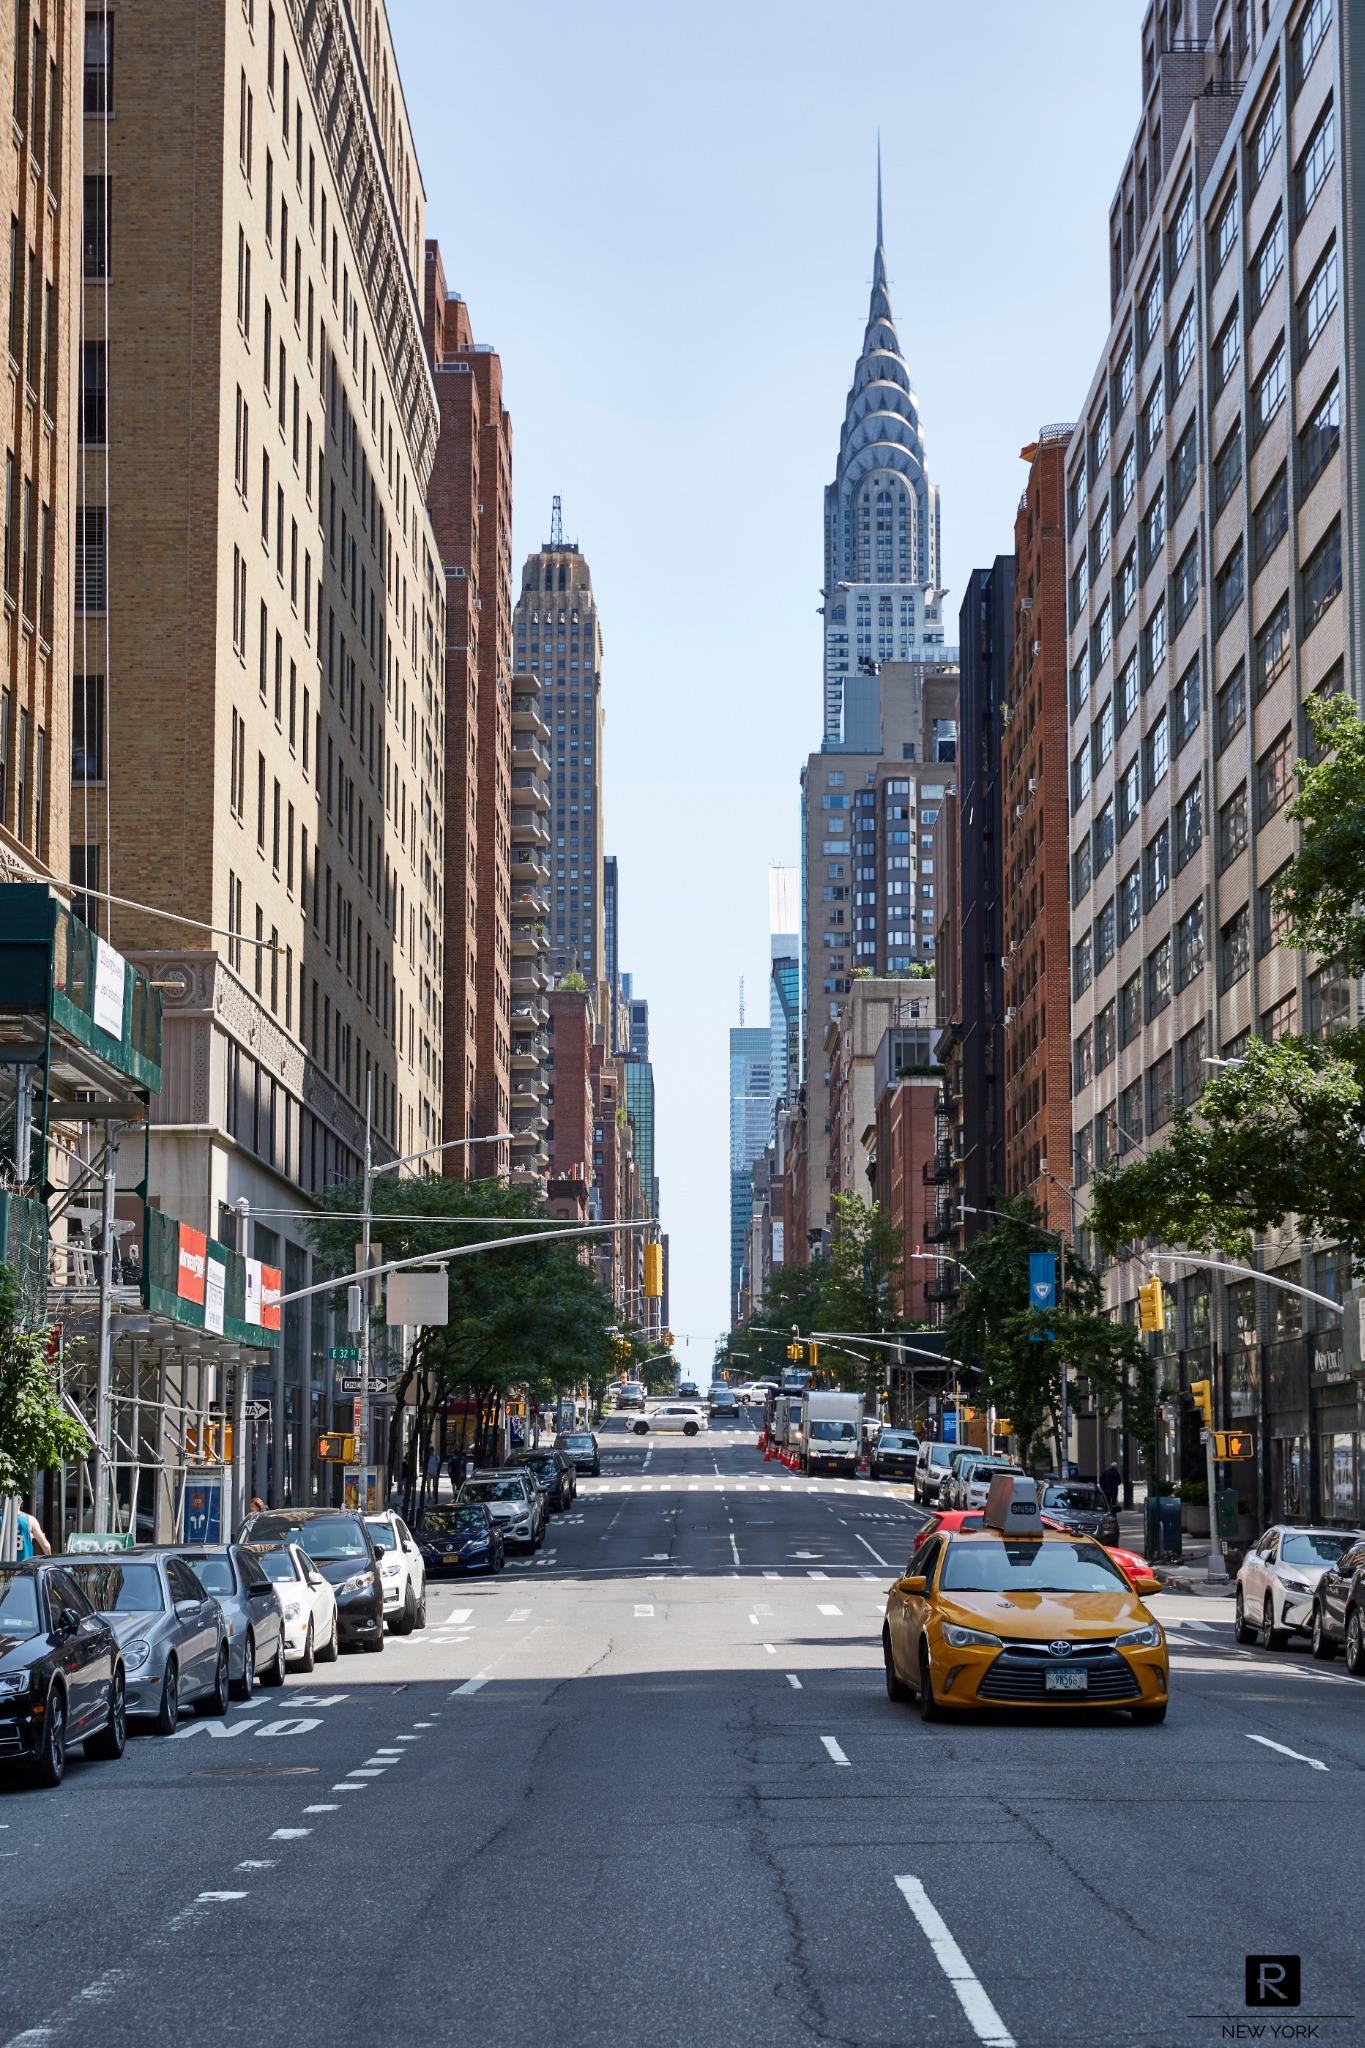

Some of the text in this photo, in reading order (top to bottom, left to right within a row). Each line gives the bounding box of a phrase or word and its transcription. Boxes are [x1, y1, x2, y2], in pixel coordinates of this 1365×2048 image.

[332, 1349, 337, 1358] E
[340, 1349, 348, 1358] 32
[1012, 1504, 1036, 1514] 9N56
